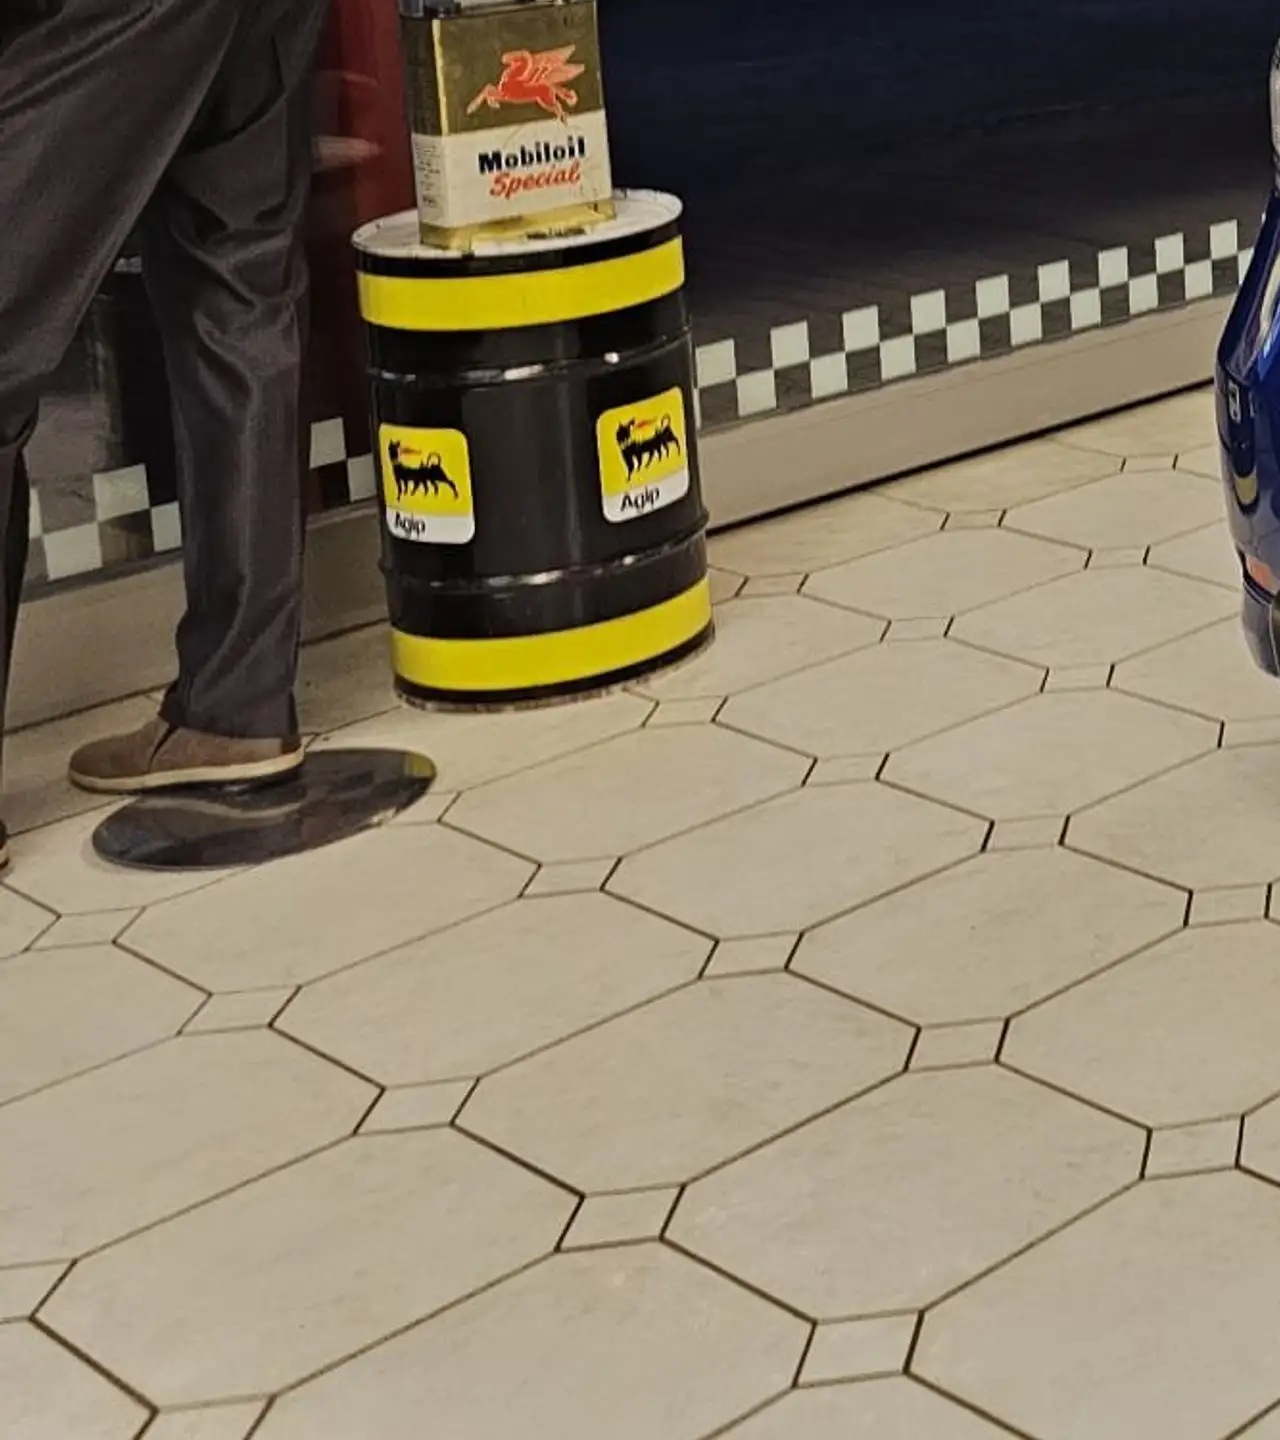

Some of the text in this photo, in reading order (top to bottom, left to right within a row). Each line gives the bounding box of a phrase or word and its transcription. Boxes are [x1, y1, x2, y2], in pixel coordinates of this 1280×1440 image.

[478, 135, 587, 175] Mobiloil
[489, 159, 582, 199] Special
[619, 488, 661, 514] Agip
[394, 511, 427, 540] Agip
